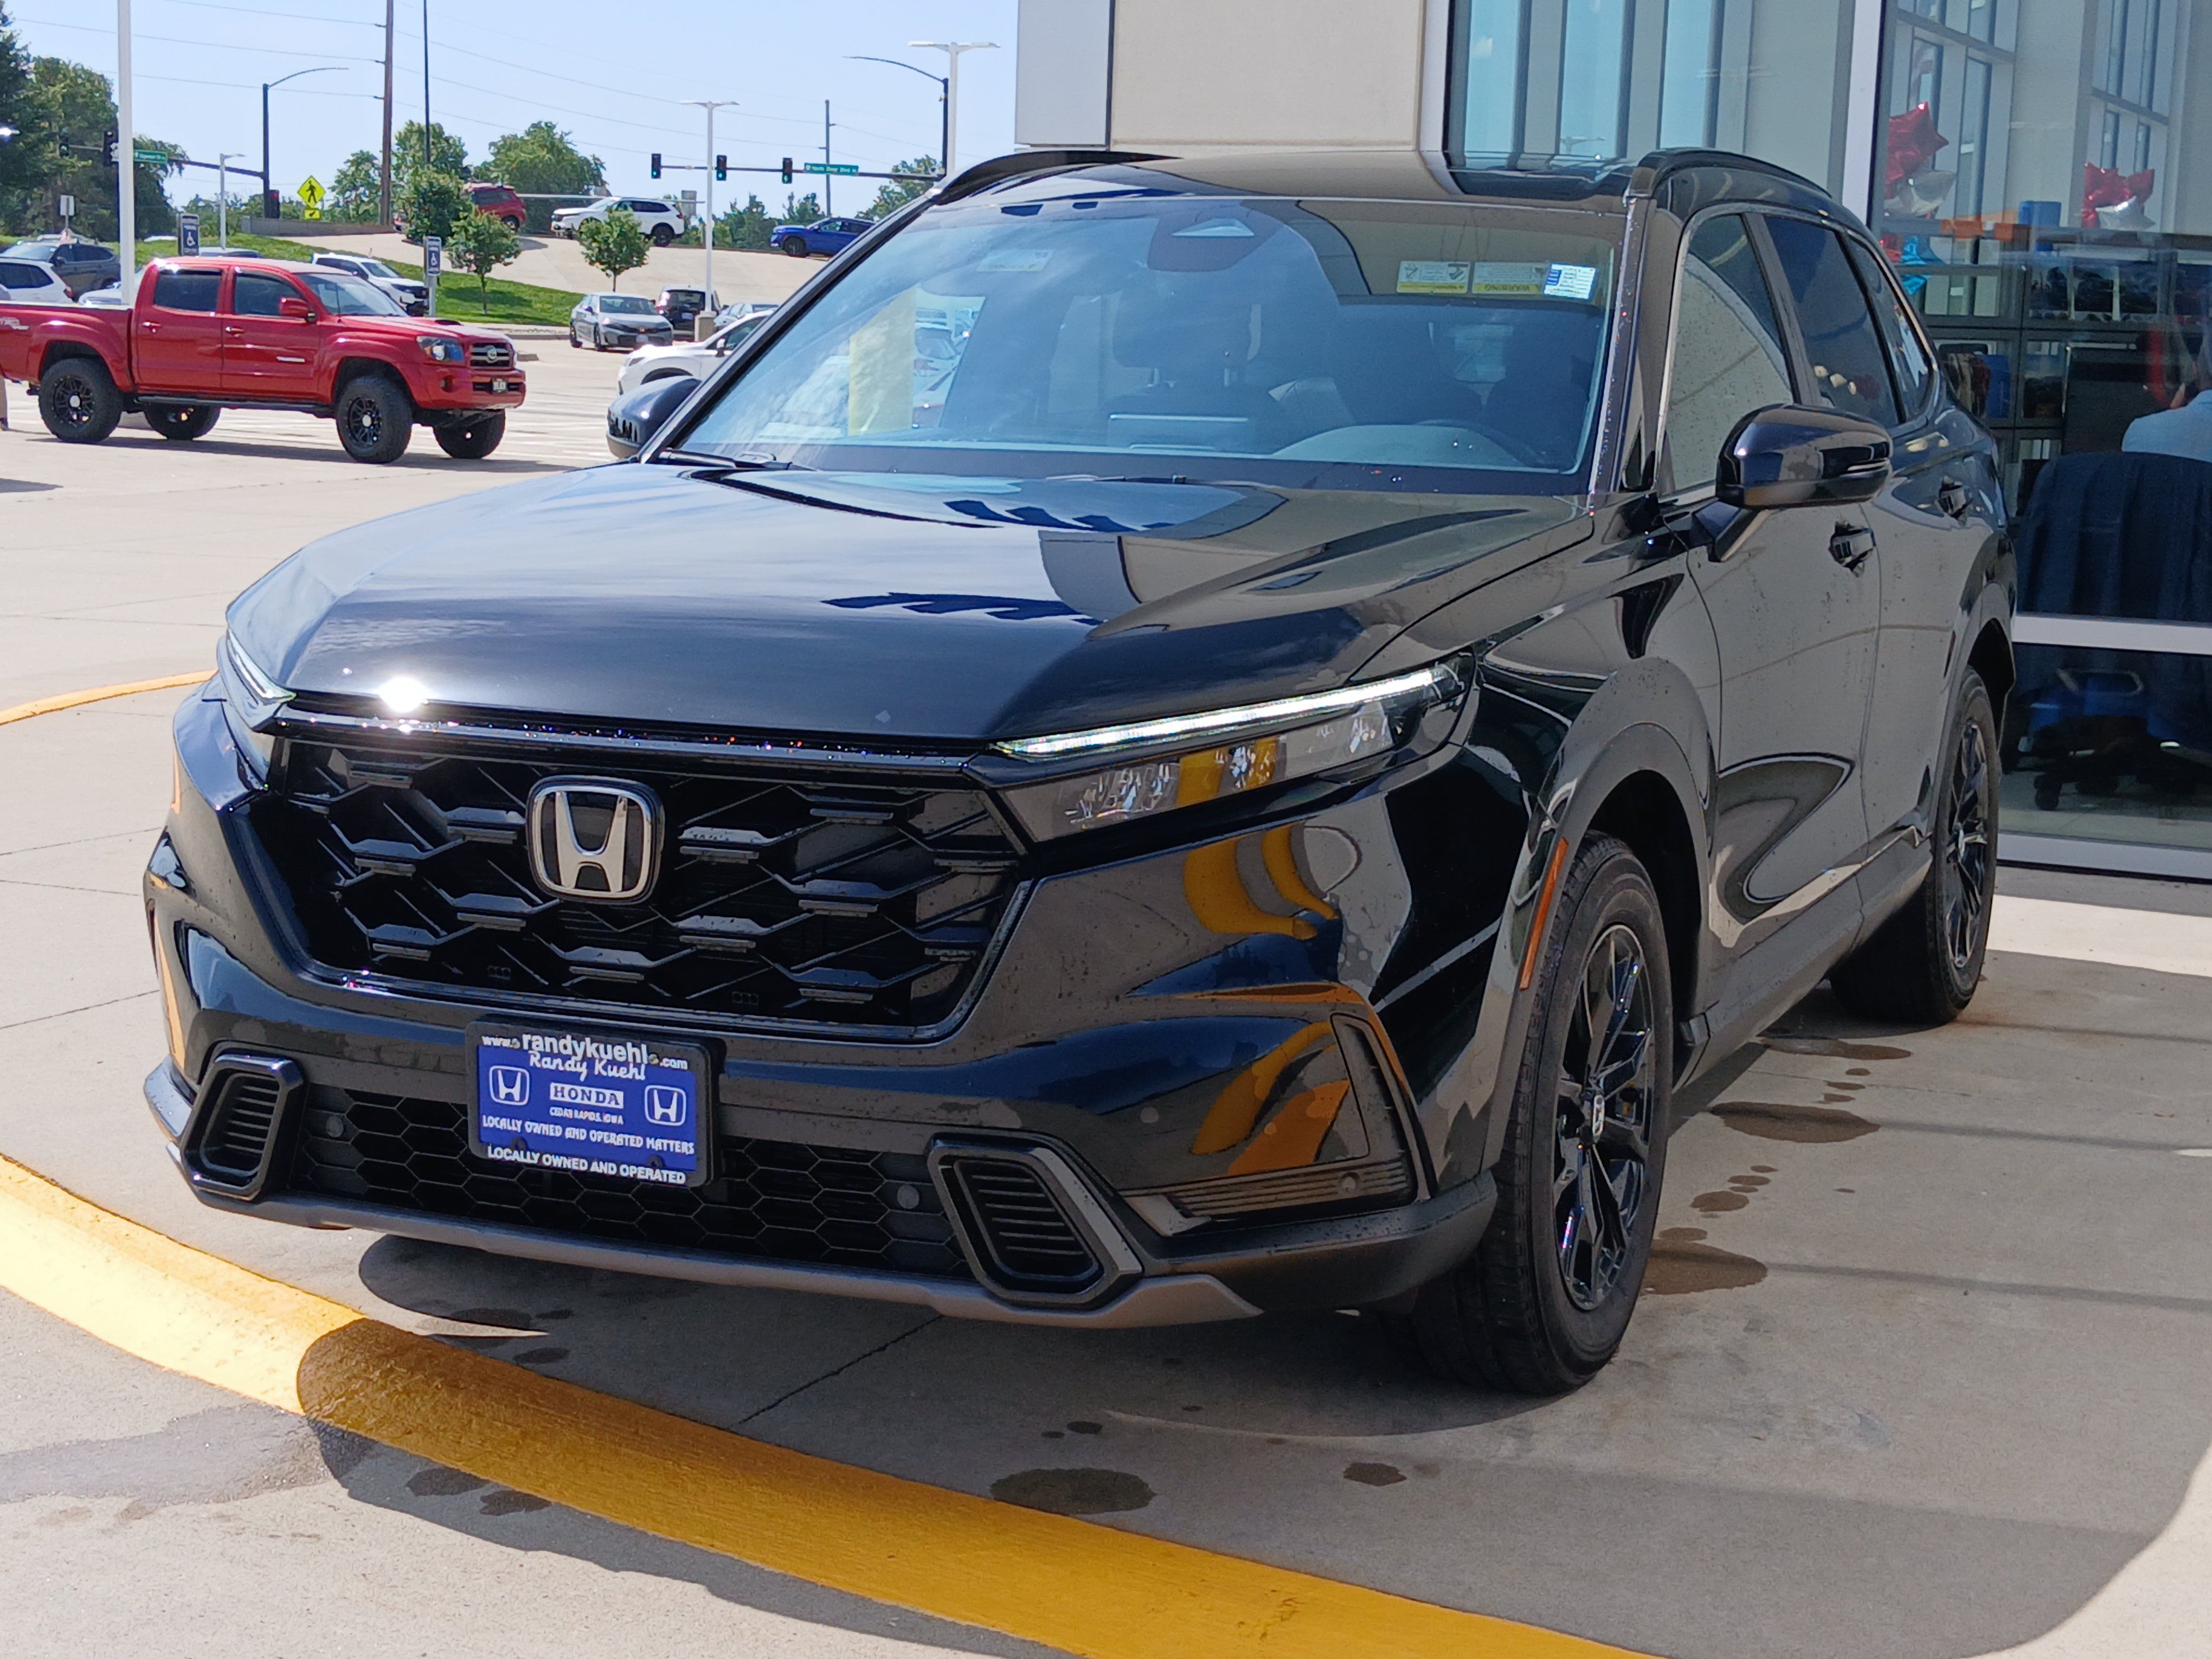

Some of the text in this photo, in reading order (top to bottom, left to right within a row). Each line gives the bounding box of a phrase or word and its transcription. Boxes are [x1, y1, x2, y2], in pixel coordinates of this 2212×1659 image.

[528, 1051, 646, 1082] Randy Kuehl
[553, 1085, 620, 1105] HONDA
[483, 1115, 695, 1155] LOCALLY OWNED AND OPERATED MATTERS
[488, 1144, 686, 1184] LOCALLY OWNED AND OPERATED
